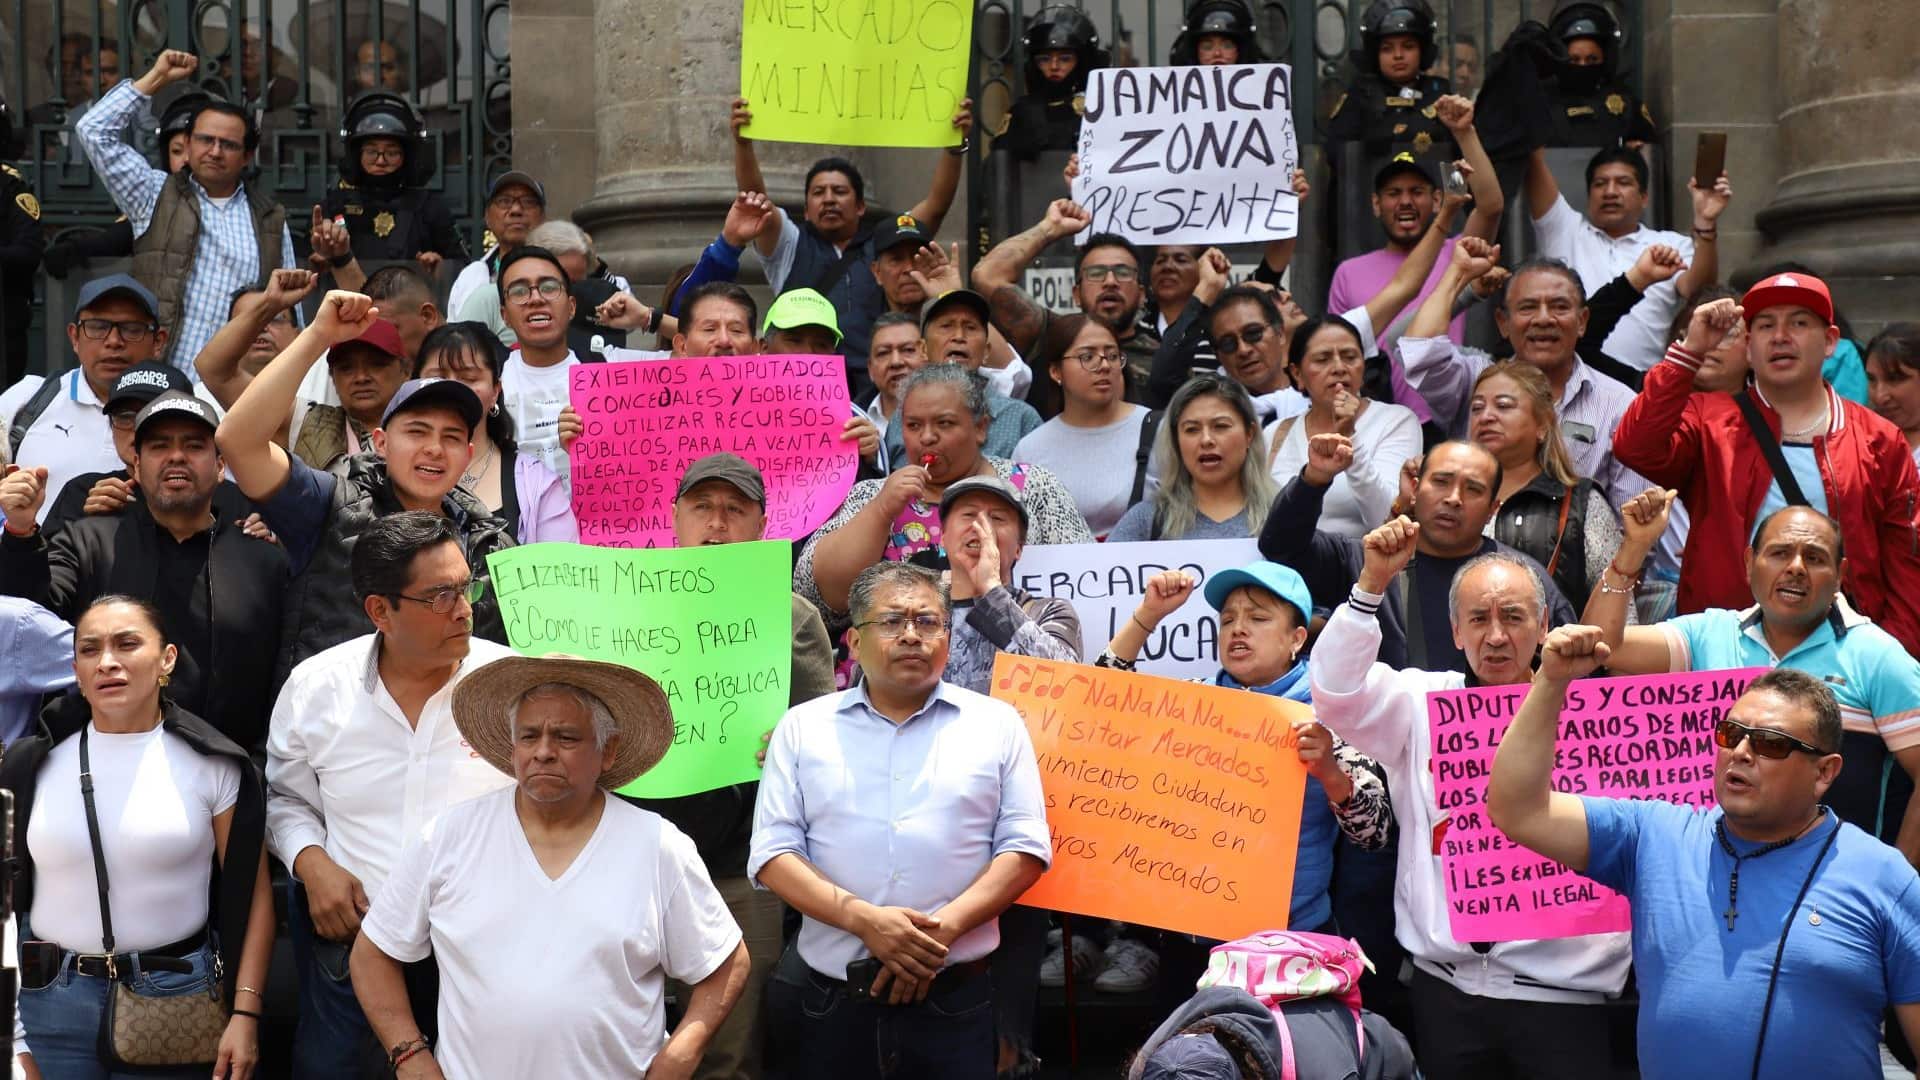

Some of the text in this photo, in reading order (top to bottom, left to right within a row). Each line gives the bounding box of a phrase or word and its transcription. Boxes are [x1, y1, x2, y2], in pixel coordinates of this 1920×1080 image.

[751, 0, 964, 51] MERCADO
[1108, 117, 1275, 175] ZONA
[700, 364, 714, 381] A
[722, 360, 838, 380] DIPUTADOS
[732, 386, 743, 406] Y
[750, 384, 844, 403] GOBIERNO
[614, 412, 704, 436] UTILIZAR
[715, 407, 835, 428] RECURSOS
[679, 436, 723, 452] PARA
[733, 435, 757, 451] LA
[765, 432, 832, 451] VENTA
[577, 461, 641, 480] ILEGAL
[647, 459, 668, 473] DE
[756, 454, 857, 473] DISFRAZADA
[575, 502, 584, 516] Y
[590, 497, 645, 513] CULTO
[652, 496, 663, 510] A
[600, 479, 663, 496] ACTOS
[493, 560, 715, 598] ELIZABETH MATEOS
[584, 625, 600, 650] LE
[611, 626, 681, 656] HACES
[697, 617, 758, 654] PARA
[695, 667, 780, 704] PÚBLICA
[1598, 687, 1614, 711] Y
[1042, 705, 1141, 750] Visitar
[1437, 731, 1480, 754] LOS
[1646, 712, 1675, 735] DE
[1152, 772, 1266, 824] Ciudadano
[1440, 786, 1478, 810] LOS
[1599, 769, 1650, 790] PARA
[1069, 793, 1245, 853] recibiremos en
[1454, 883, 1600, 914] VENTA ILEGAL
